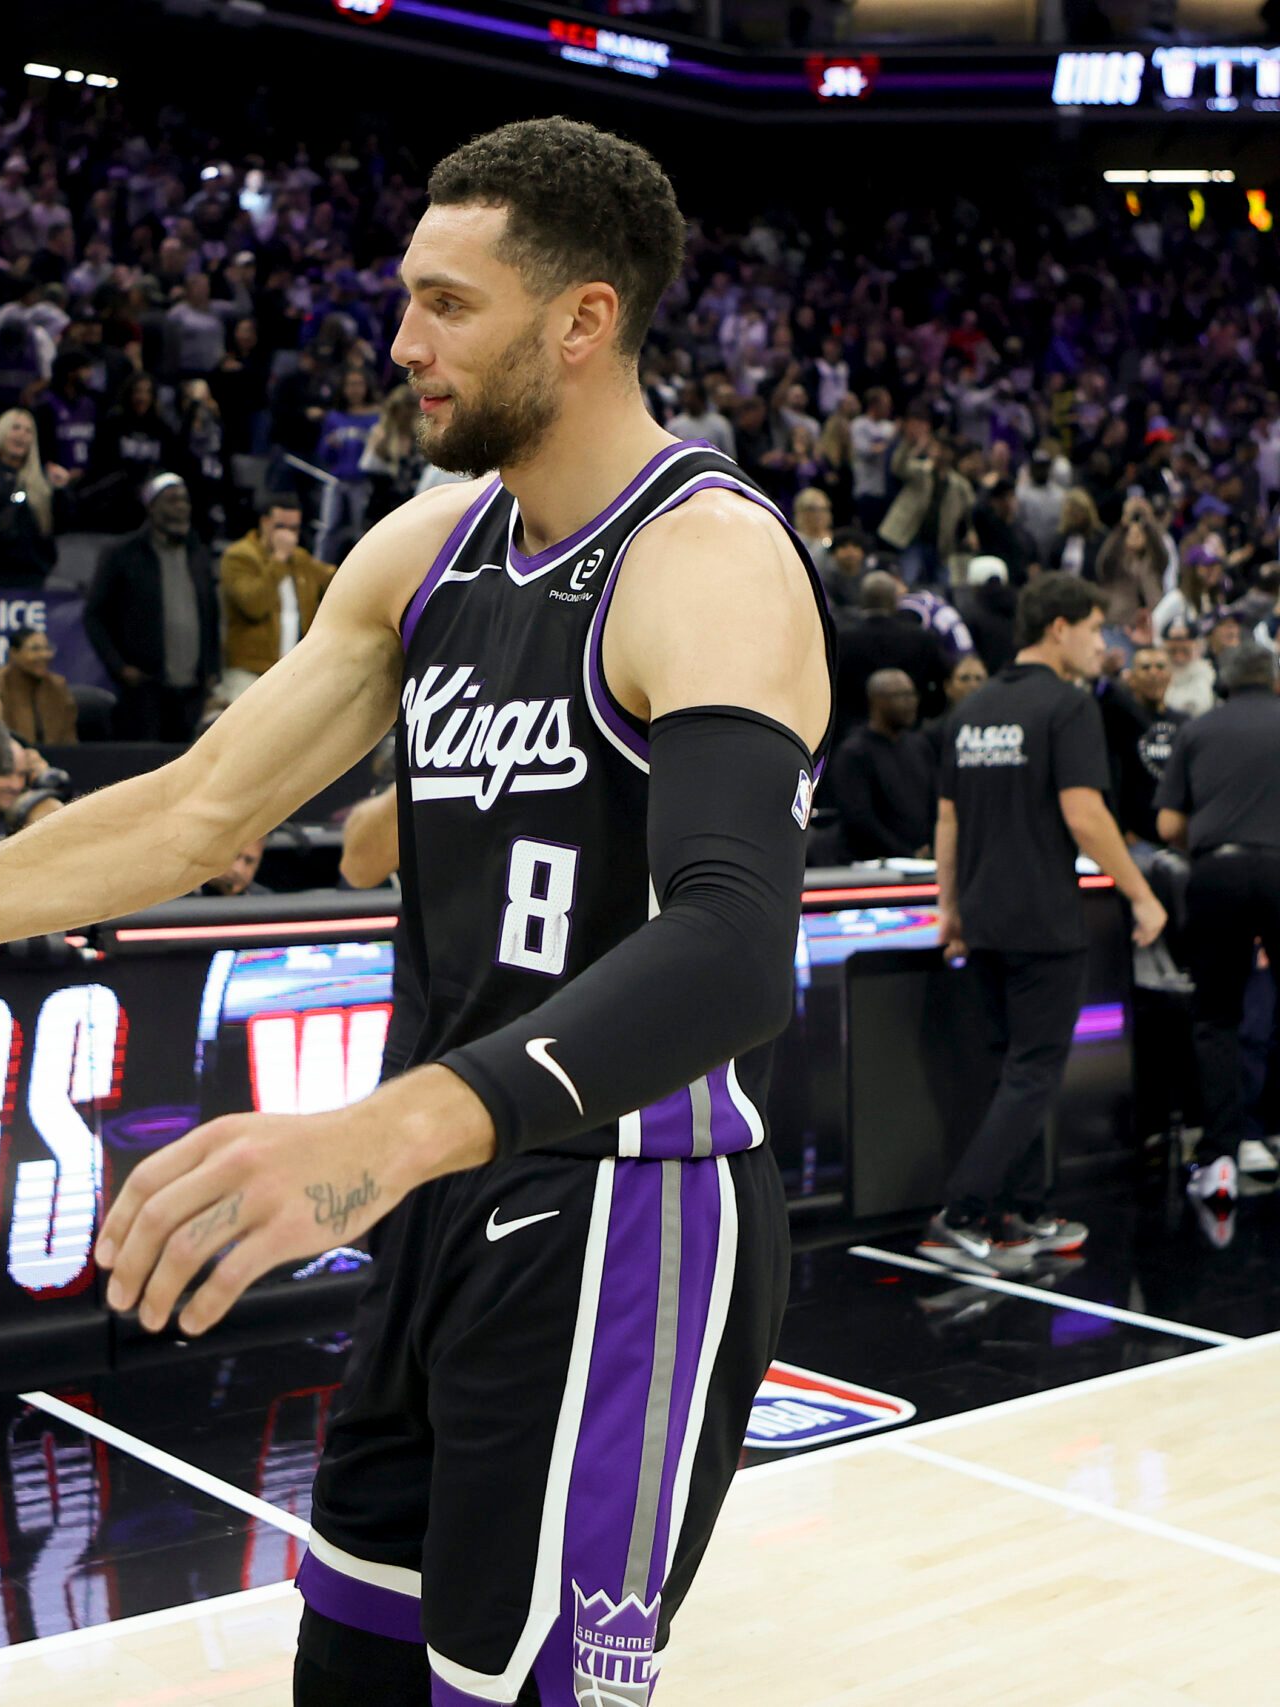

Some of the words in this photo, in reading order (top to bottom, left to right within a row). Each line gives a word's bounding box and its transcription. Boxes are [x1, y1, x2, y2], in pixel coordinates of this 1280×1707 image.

[401, 665, 587, 811] Kings
[496, 836, 580, 976] 8
[575, 1642, 652, 1684] KING
[577, 1625, 655, 1650] SACRAME
